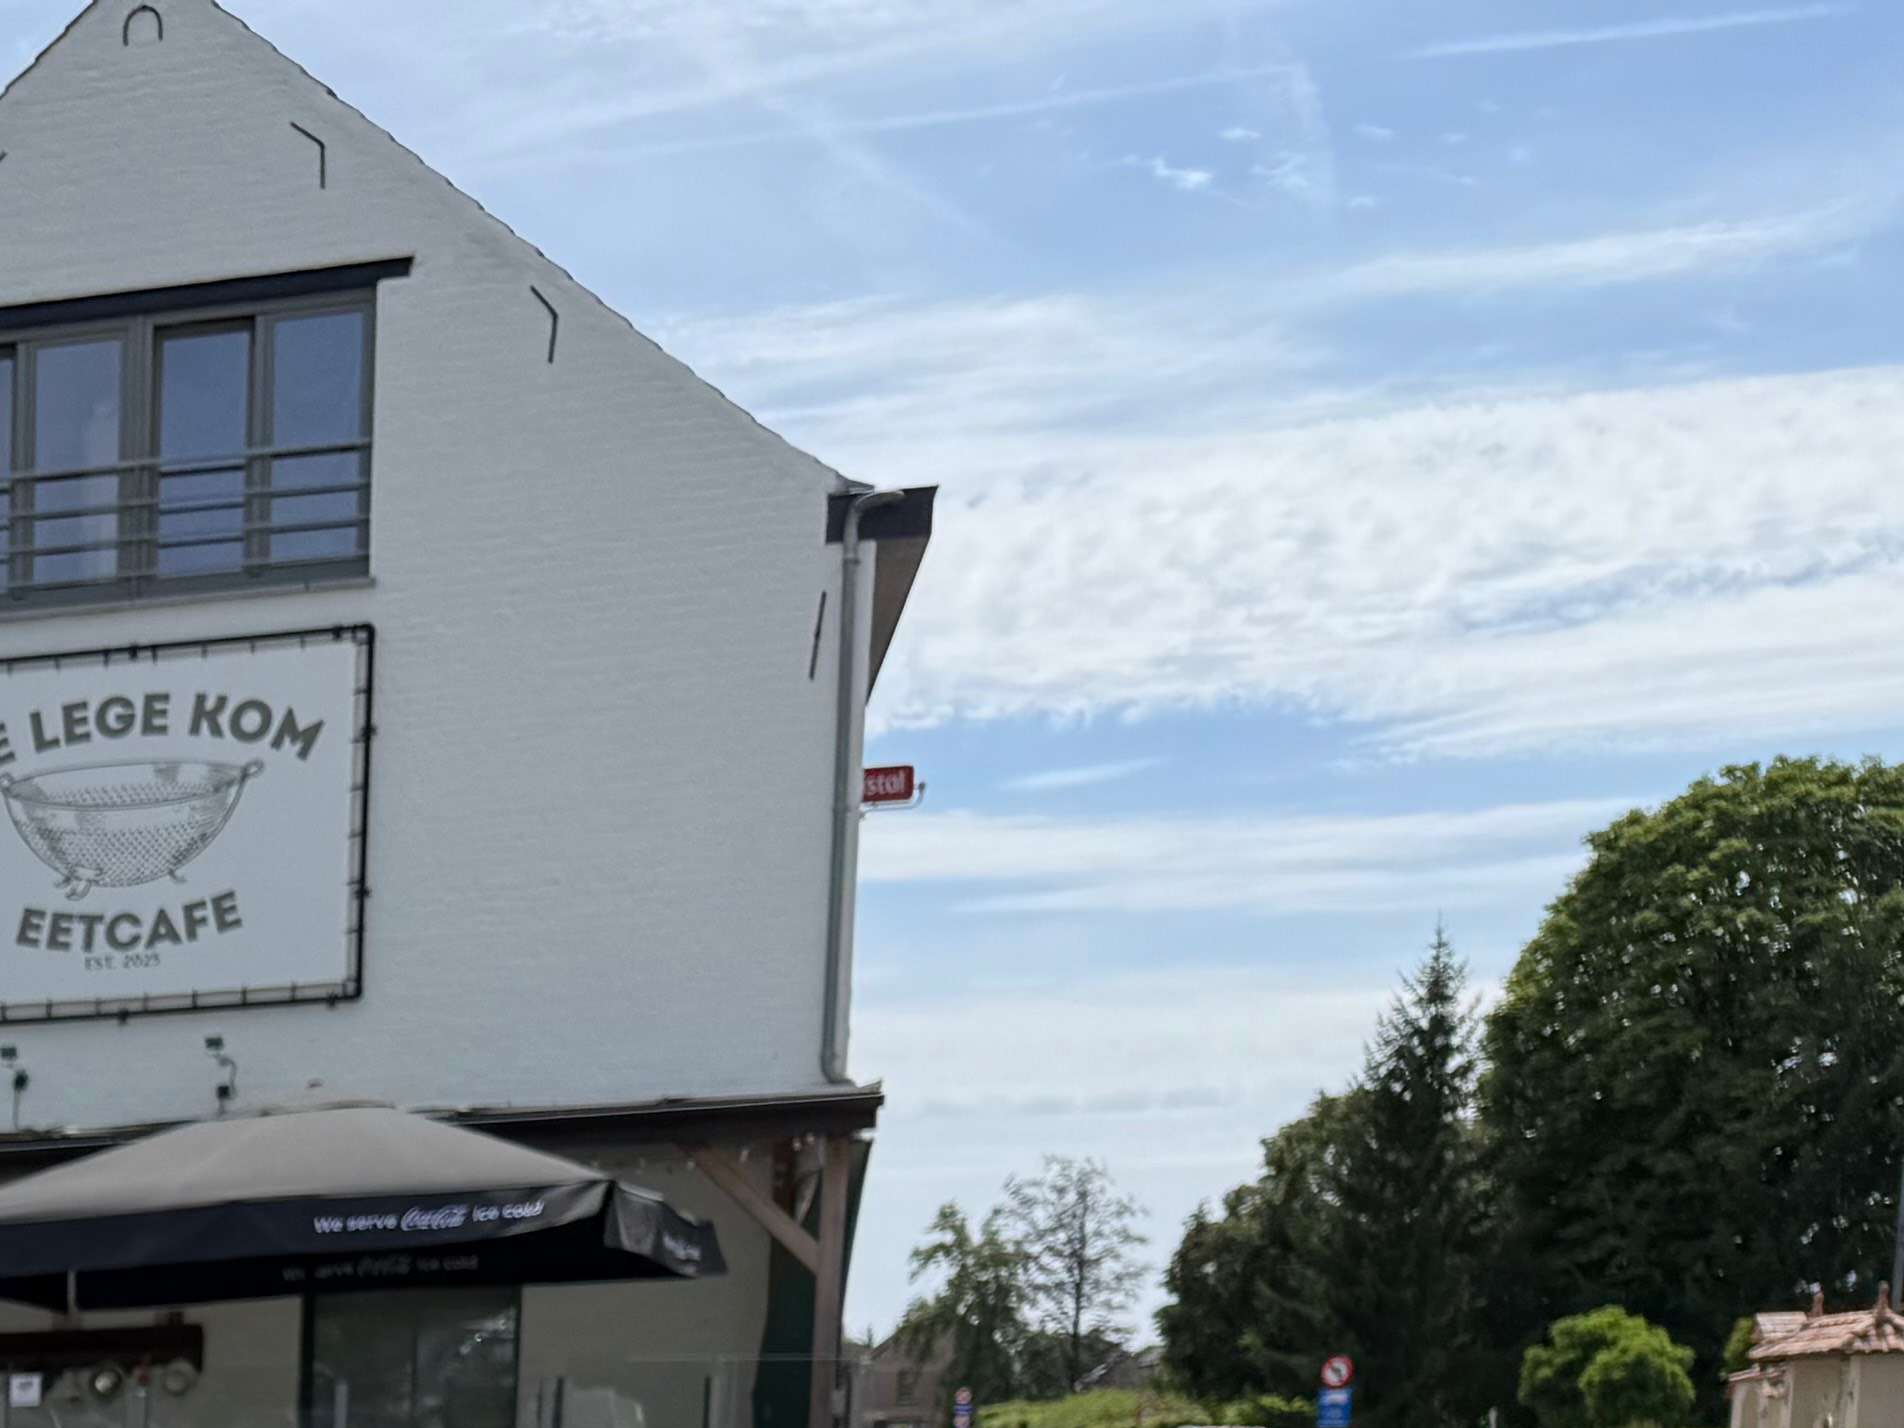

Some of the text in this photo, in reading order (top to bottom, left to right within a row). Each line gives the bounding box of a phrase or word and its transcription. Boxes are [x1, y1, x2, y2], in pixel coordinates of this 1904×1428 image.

[29, 693, 170, 753] LEGE
[188, 693, 325, 761] KOM
[16, 891, 243, 952] EETCAFE
[313, 1216, 342, 1233] We
[346, 1213, 397, 1231] serve
